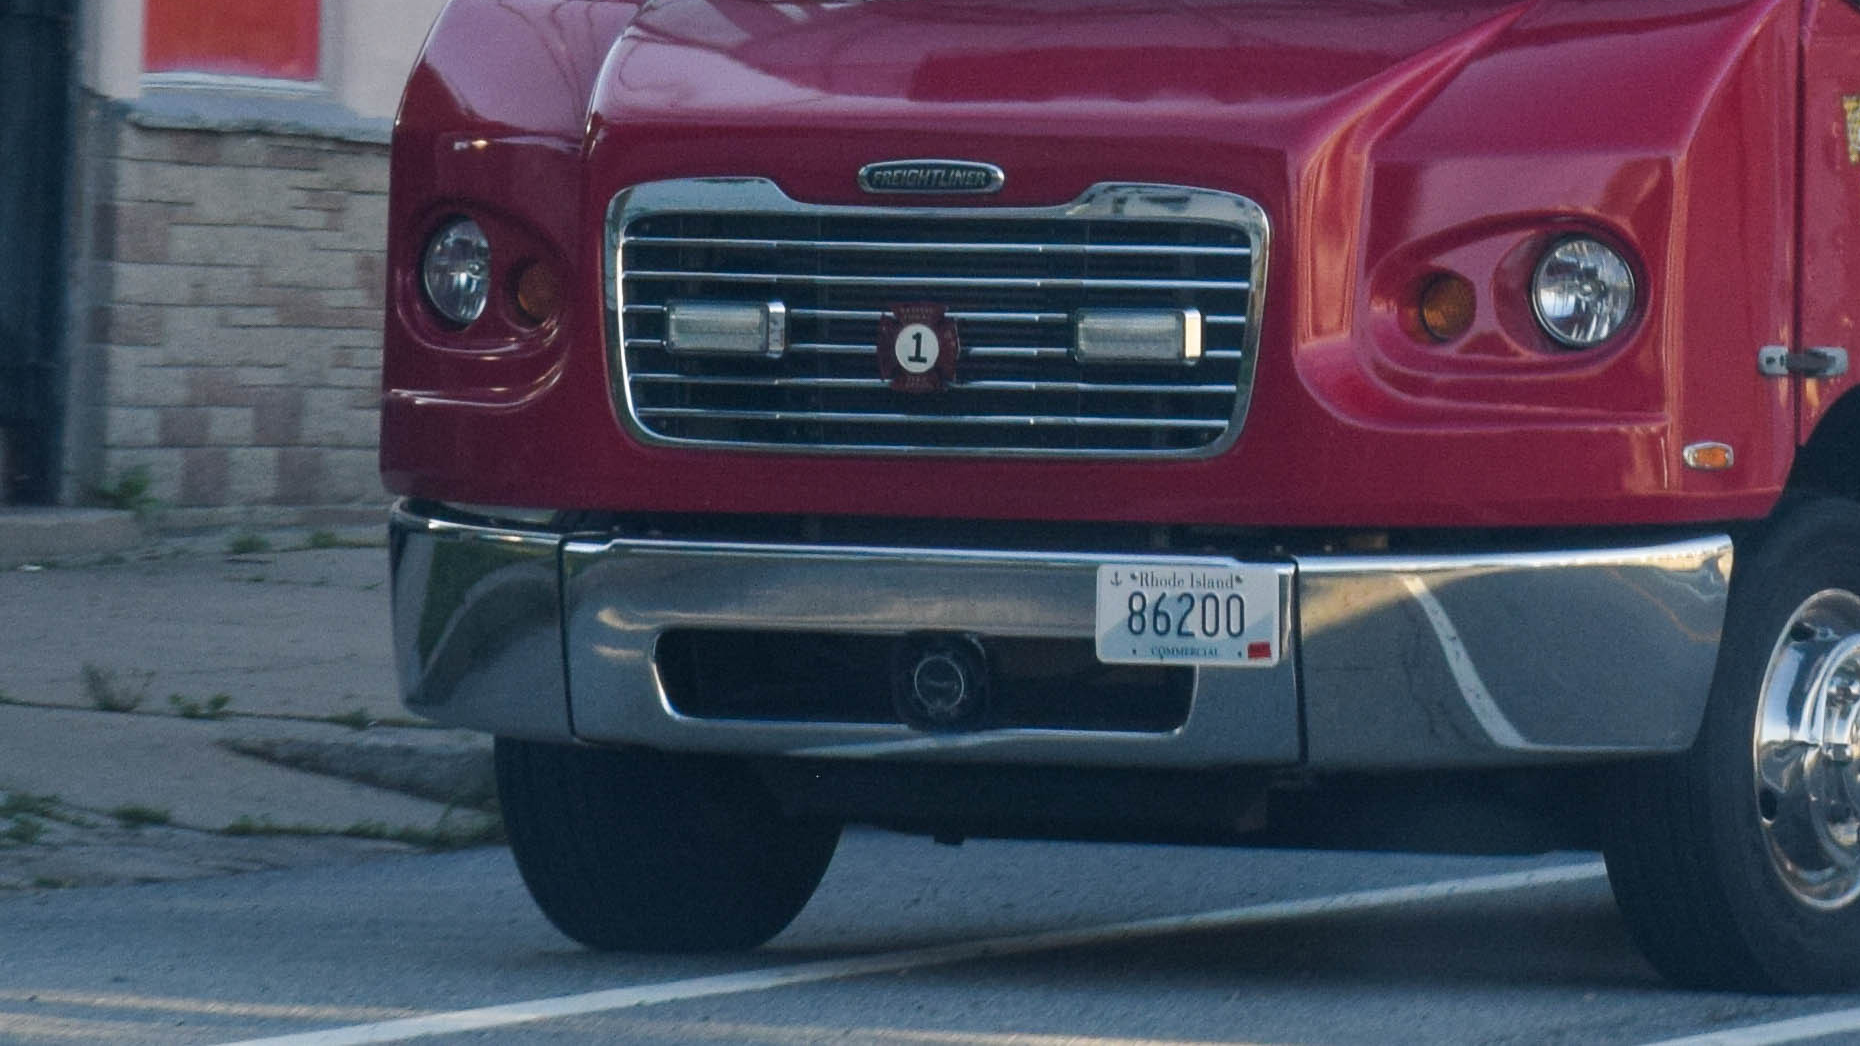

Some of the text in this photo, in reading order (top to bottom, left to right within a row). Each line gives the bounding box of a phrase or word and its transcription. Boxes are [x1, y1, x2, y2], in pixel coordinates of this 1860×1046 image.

[873, 168, 986, 187] FREIGHTLINER
[907, 331, 929, 365] 1
[1140, 572, 1236, 591] Rhode Island
[1127, 591, 1246, 638] 86200
[1151, 646, 1220, 660] COMMERCIAL
